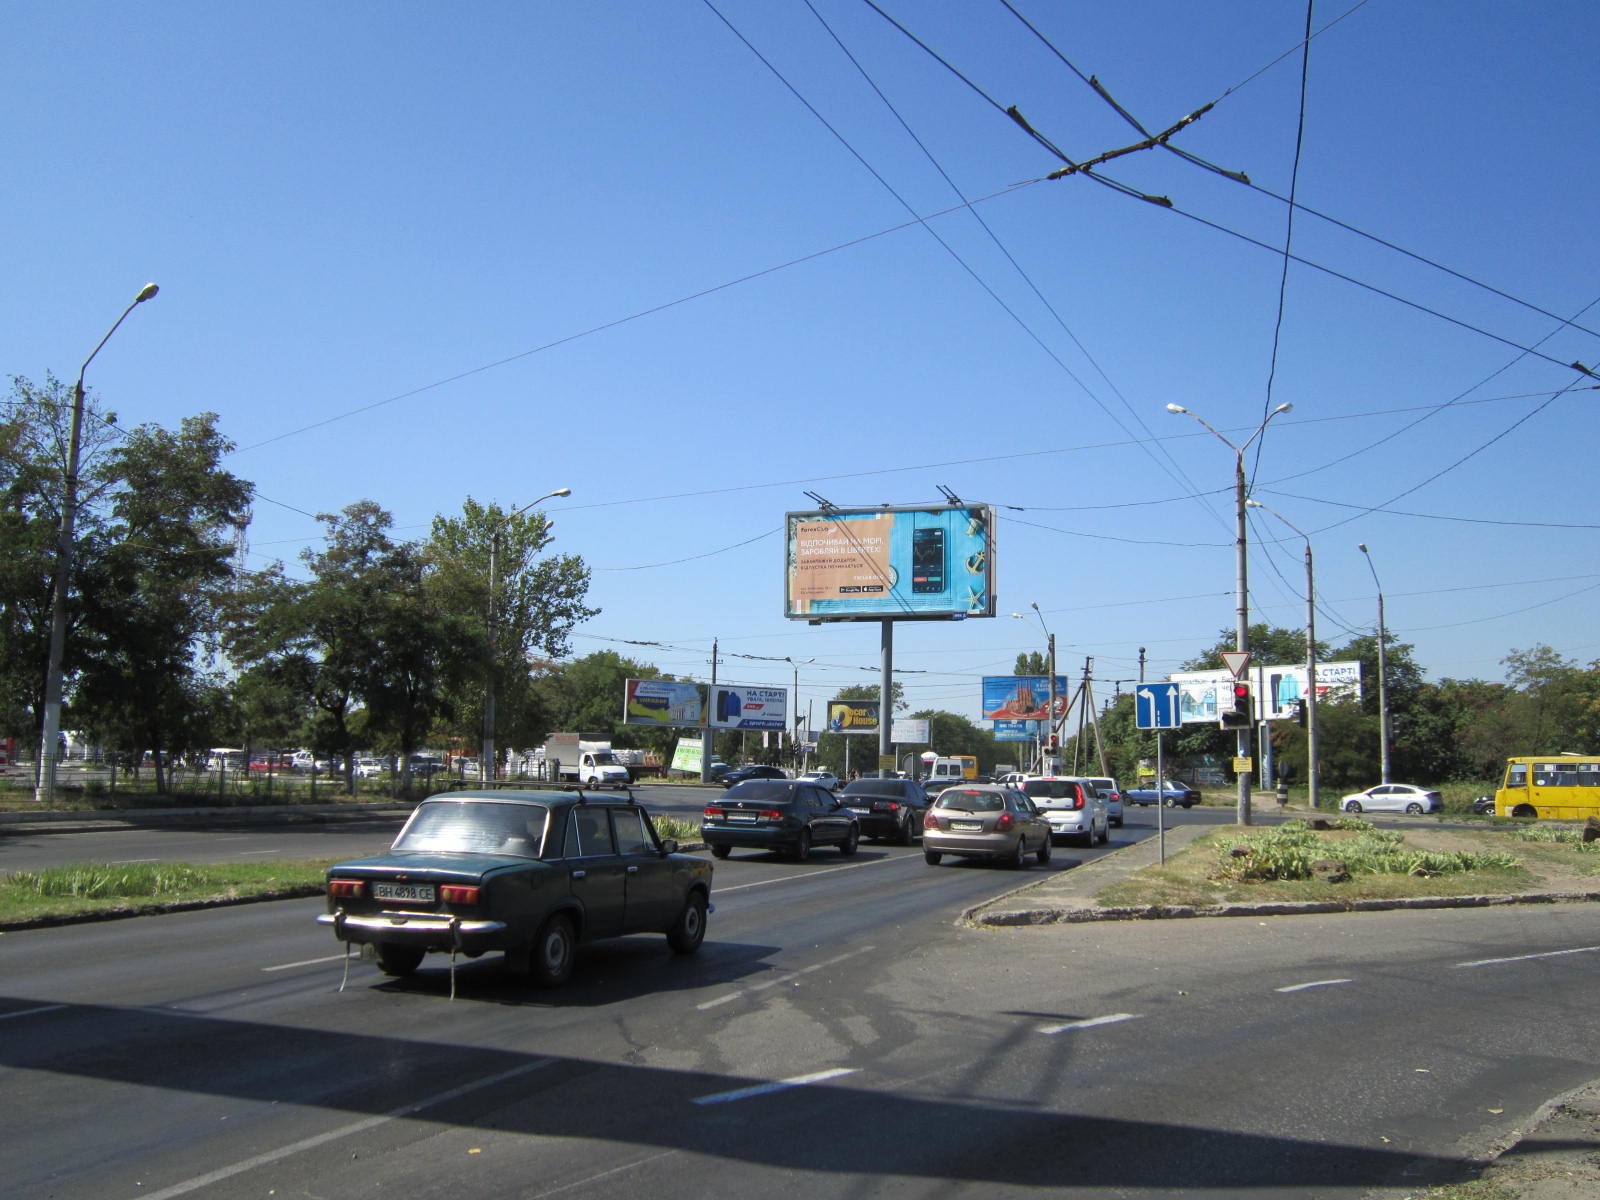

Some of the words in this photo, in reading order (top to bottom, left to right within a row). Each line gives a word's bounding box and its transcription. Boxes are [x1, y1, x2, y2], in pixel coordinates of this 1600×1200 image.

[1322, 667, 1355, 677] СТАРТ!
[378, 886, 393, 897] BH
[419, 888, 433, 900] CE
